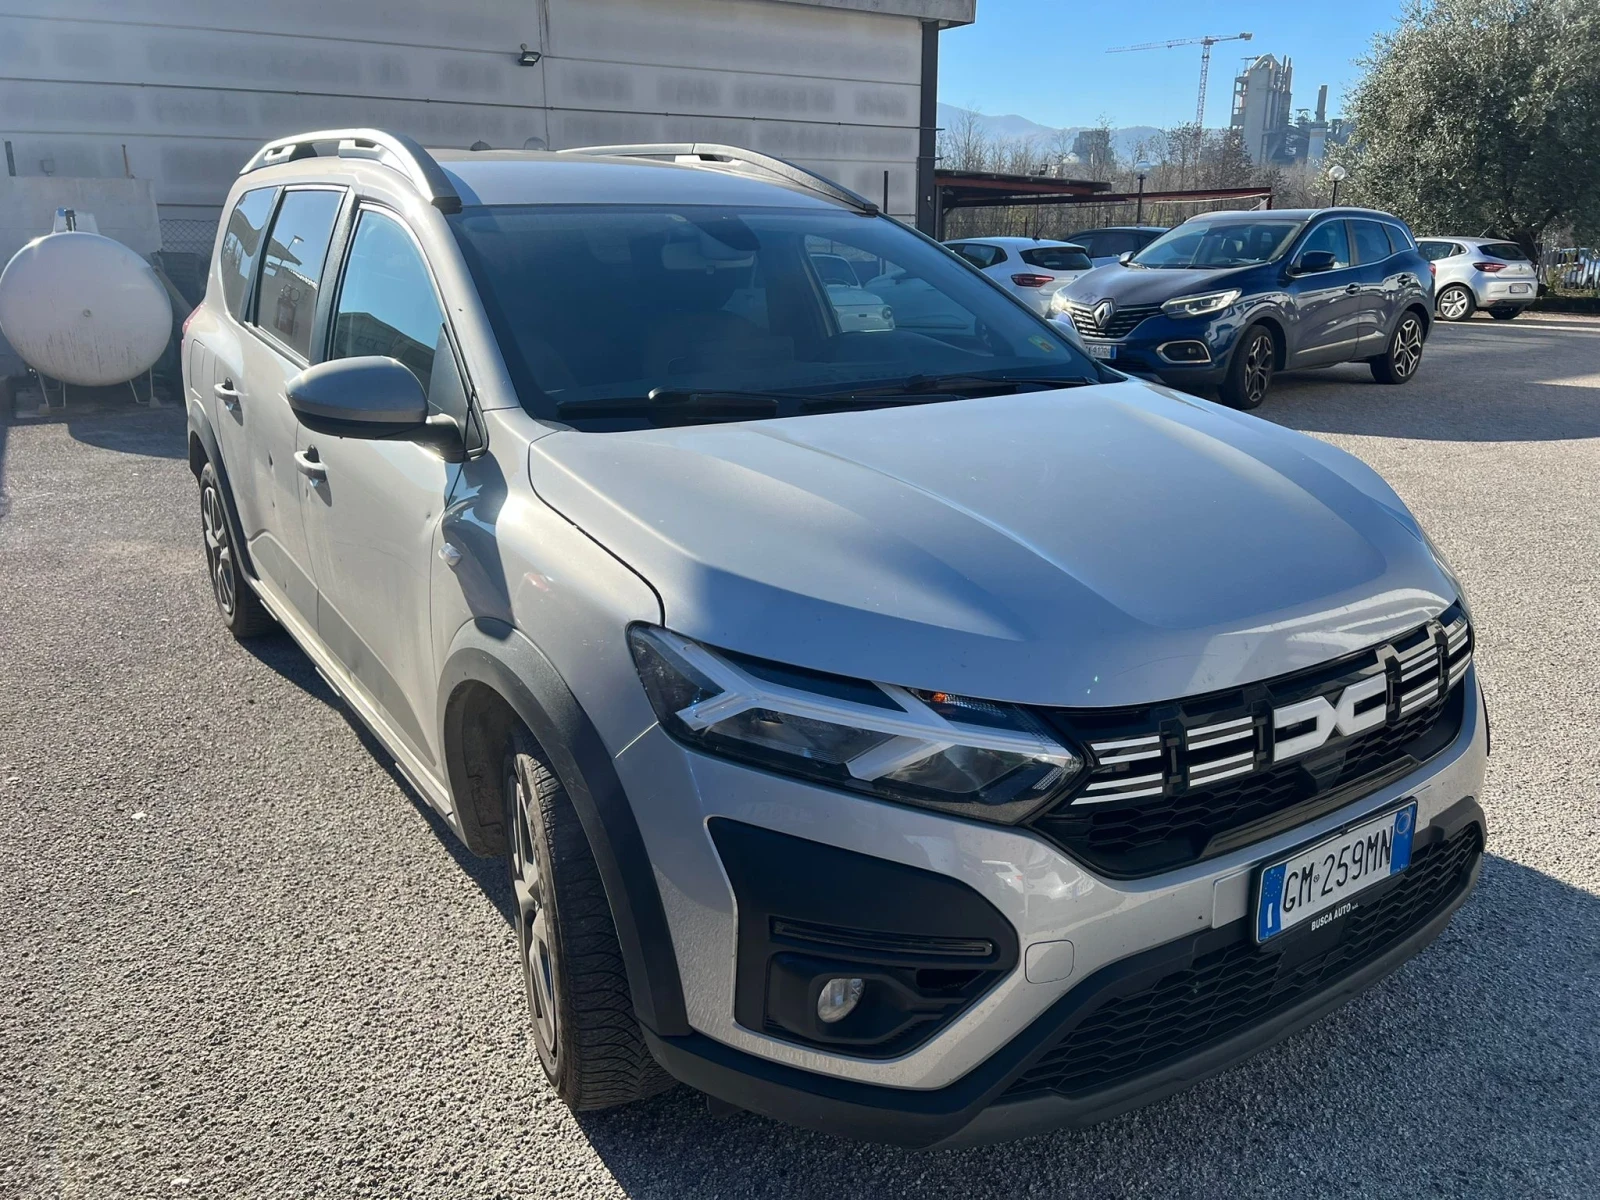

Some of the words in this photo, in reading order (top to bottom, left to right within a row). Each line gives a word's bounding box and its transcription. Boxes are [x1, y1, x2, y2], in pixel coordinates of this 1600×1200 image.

[1283, 862, 1315, 912] GM
[1321, 825, 1394, 897] 259MN
[1311, 912, 1333, 931] BUSCA
[1333, 902, 1351, 920] AUTO
